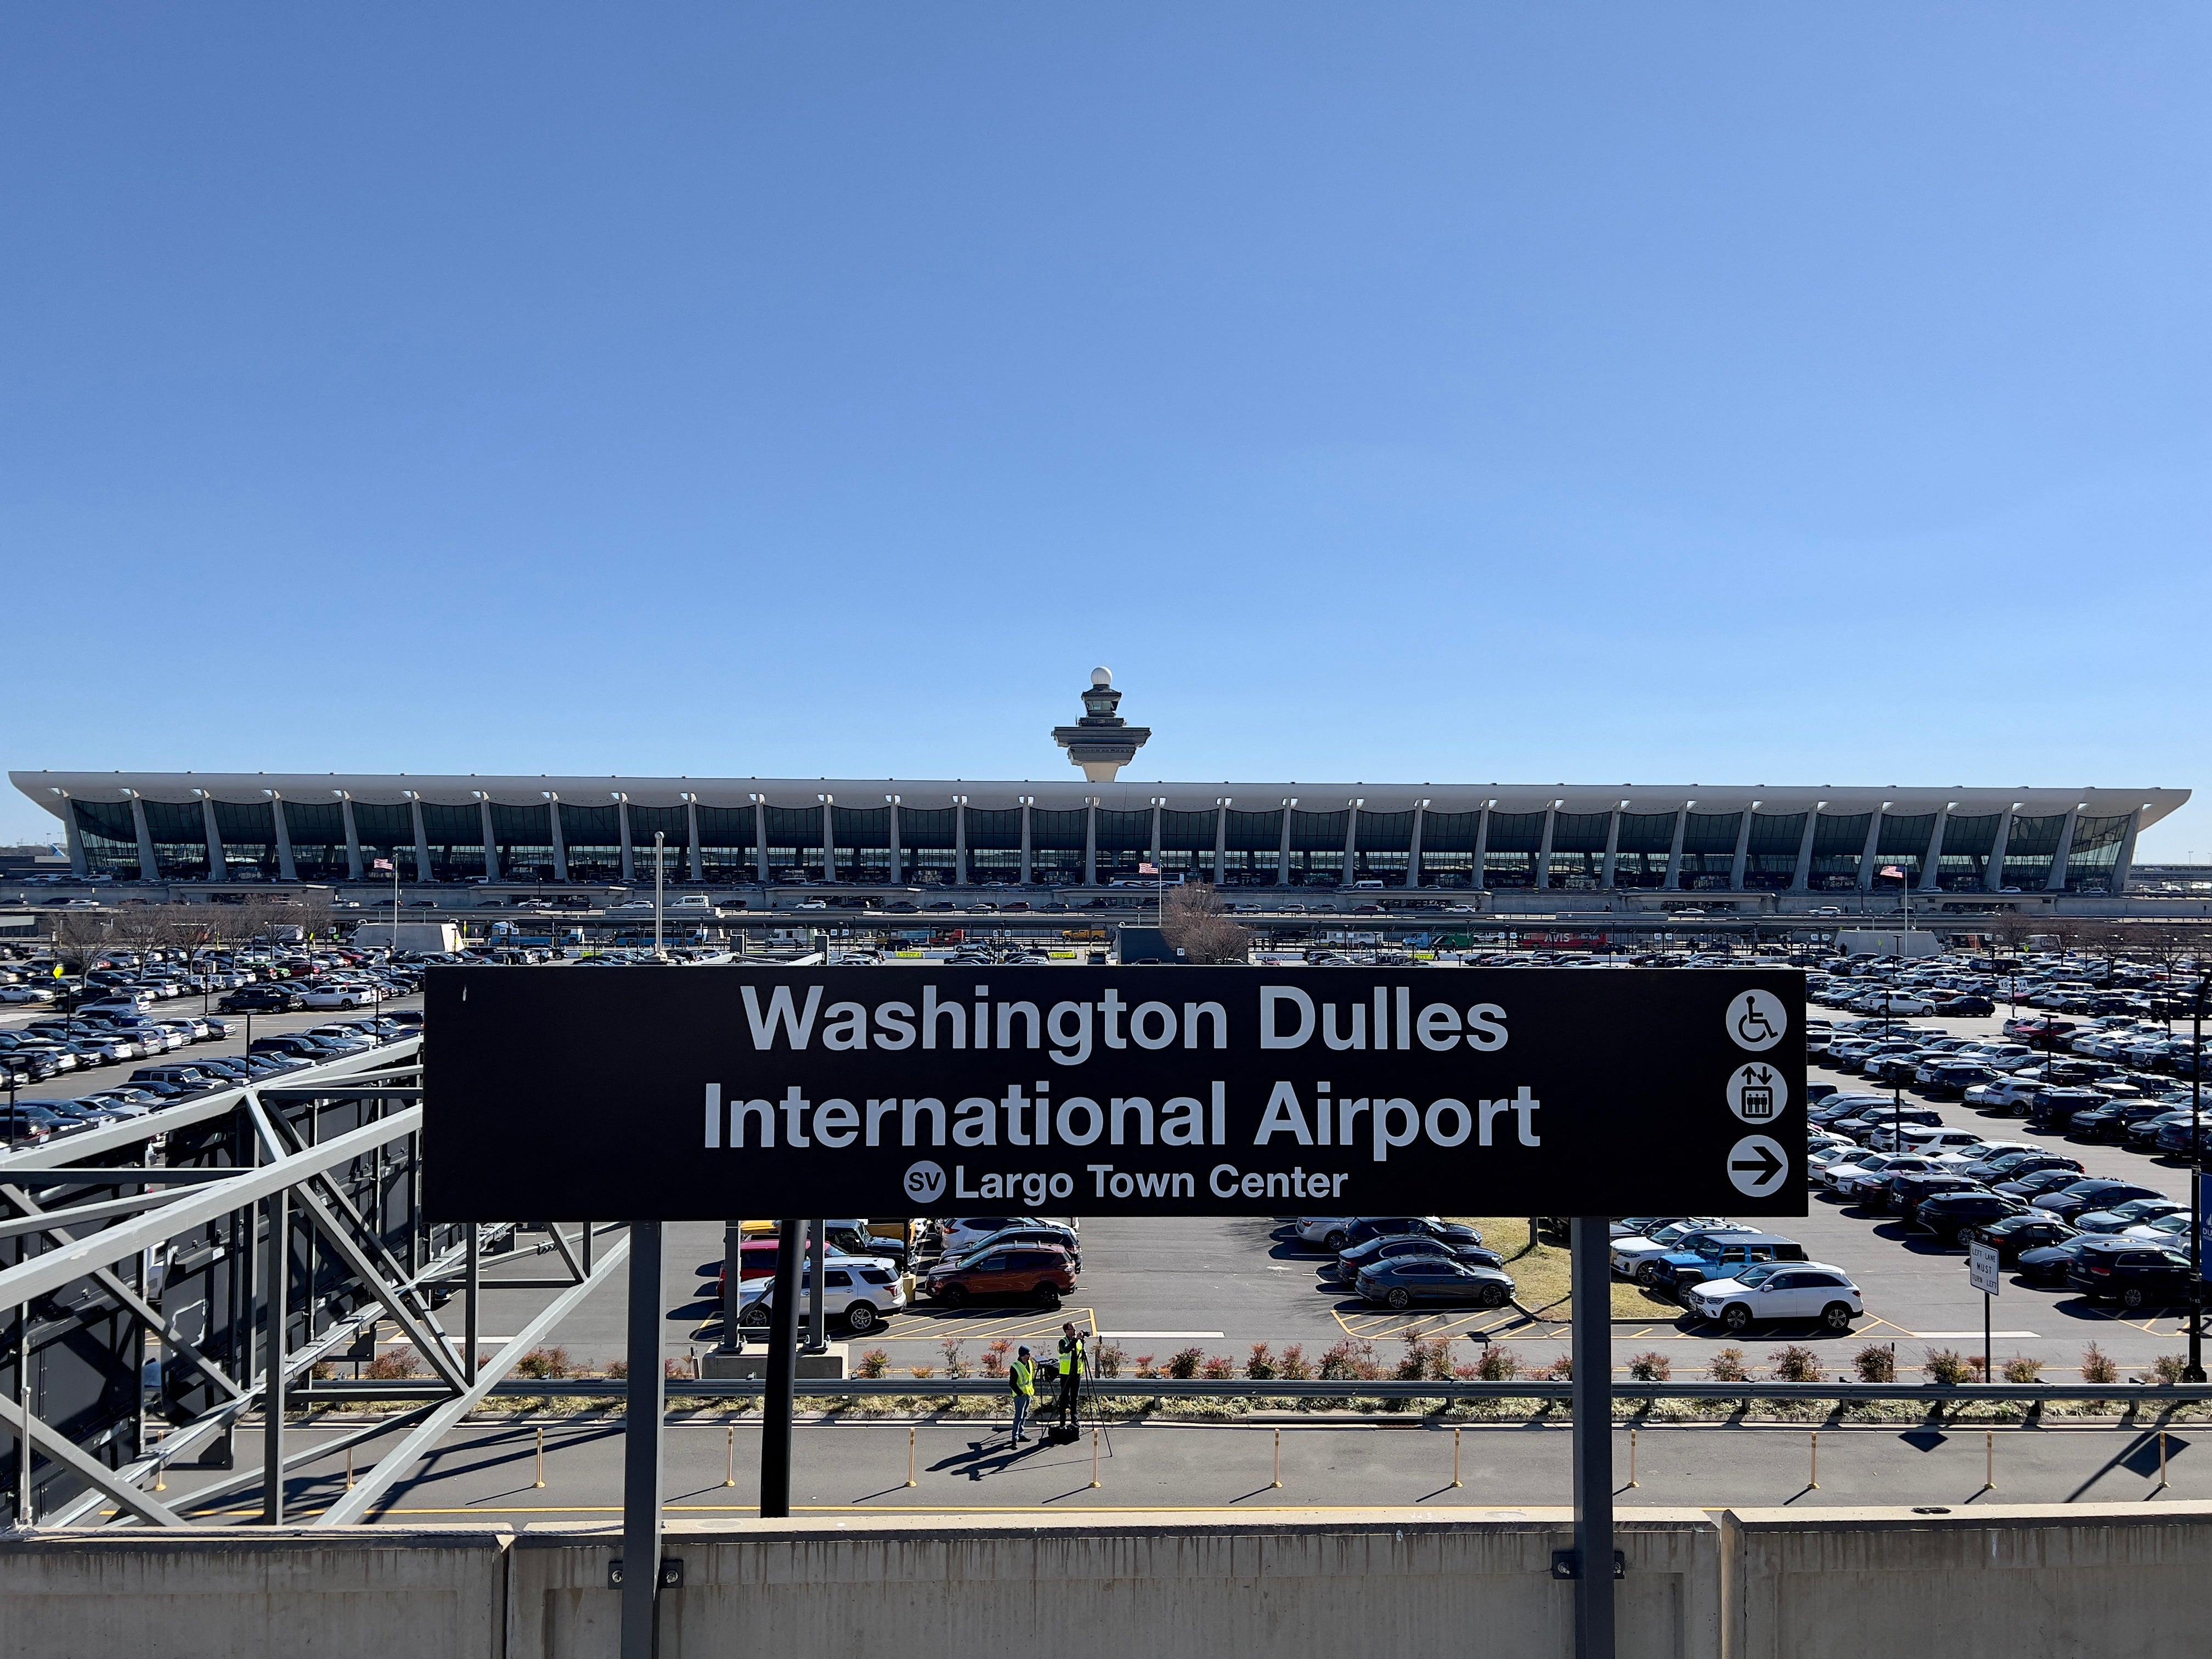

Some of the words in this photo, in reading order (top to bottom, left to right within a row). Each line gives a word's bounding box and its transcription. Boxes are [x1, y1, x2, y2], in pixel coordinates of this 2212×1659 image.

[1544, 933, 1570, 942] AVIS
[740, 985, 1227, 1066] Washington
[1260, 986, 1509, 1052] Dulles
[705, 1081, 1225, 1148] International
[1254, 1081, 1541, 1161] Airport
[908, 1171, 941, 1192] SV
[956, 1166, 1074, 1206] Largo
[1087, 1164, 1194, 1198] Town
[1210, 1164, 1348, 1198] Center
[1972, 1248, 1982, 1257] LEFT
[1985, 1253, 1996, 1263] LANE
[1977, 1262, 1992, 1275] MUST
[1972, 1273, 1983, 1283] TURN
[1987, 1280, 1997, 1289] LEFT
